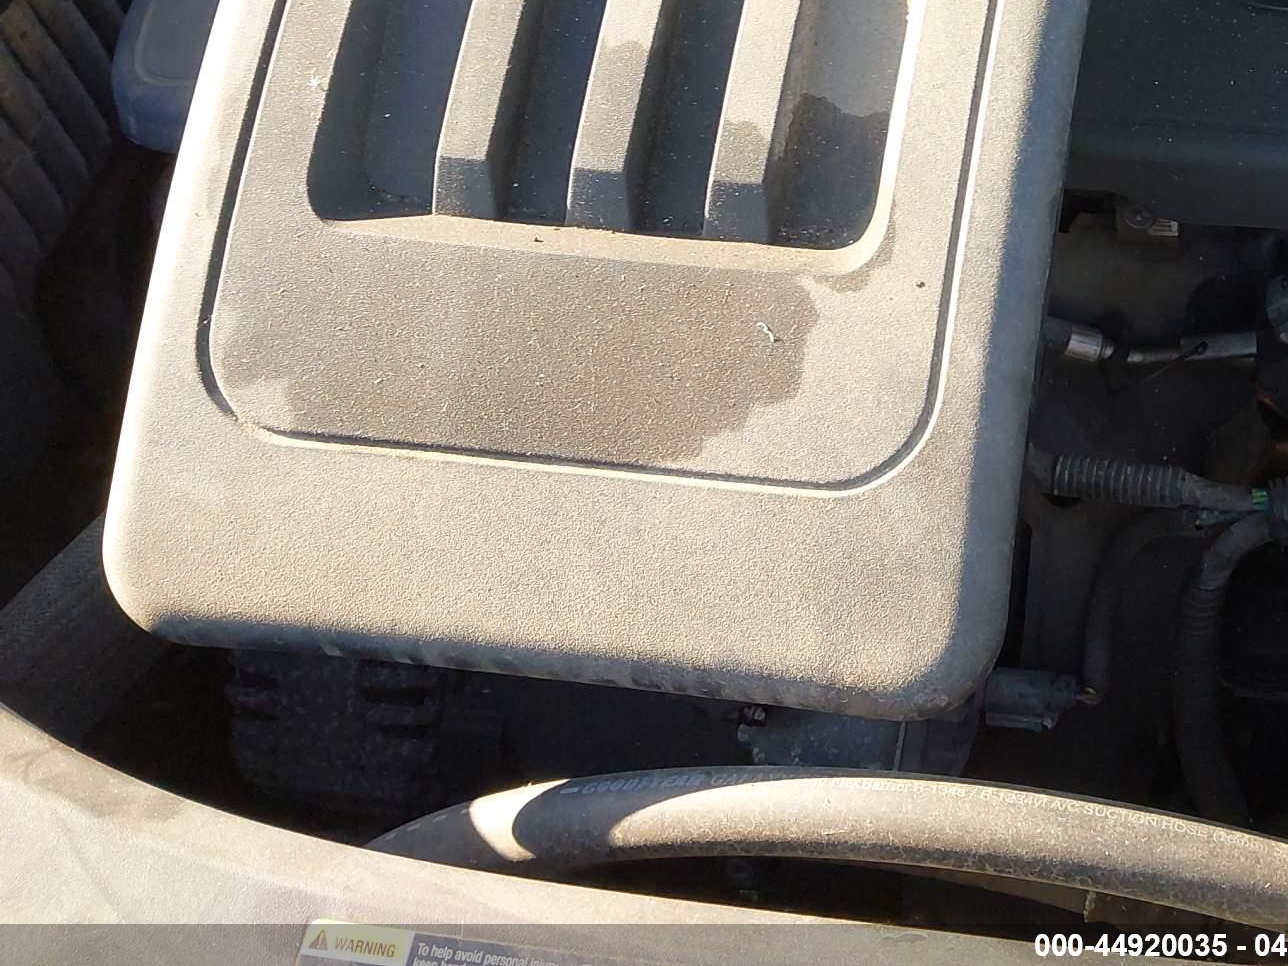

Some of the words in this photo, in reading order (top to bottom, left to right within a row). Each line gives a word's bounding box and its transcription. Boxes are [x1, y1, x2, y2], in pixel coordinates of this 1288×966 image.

[1082, 803, 1158, 828] SUCTION
[1161, 817, 1209, 837] HOSE
[335, 936, 398, 958] WARNING
[417, 942, 429, 955] To
[430, 944, 453, 961] help
[454, 949, 484, 963] avoid
[483, 953, 529, 966] personal
[530, 957, 559, 966] inju
